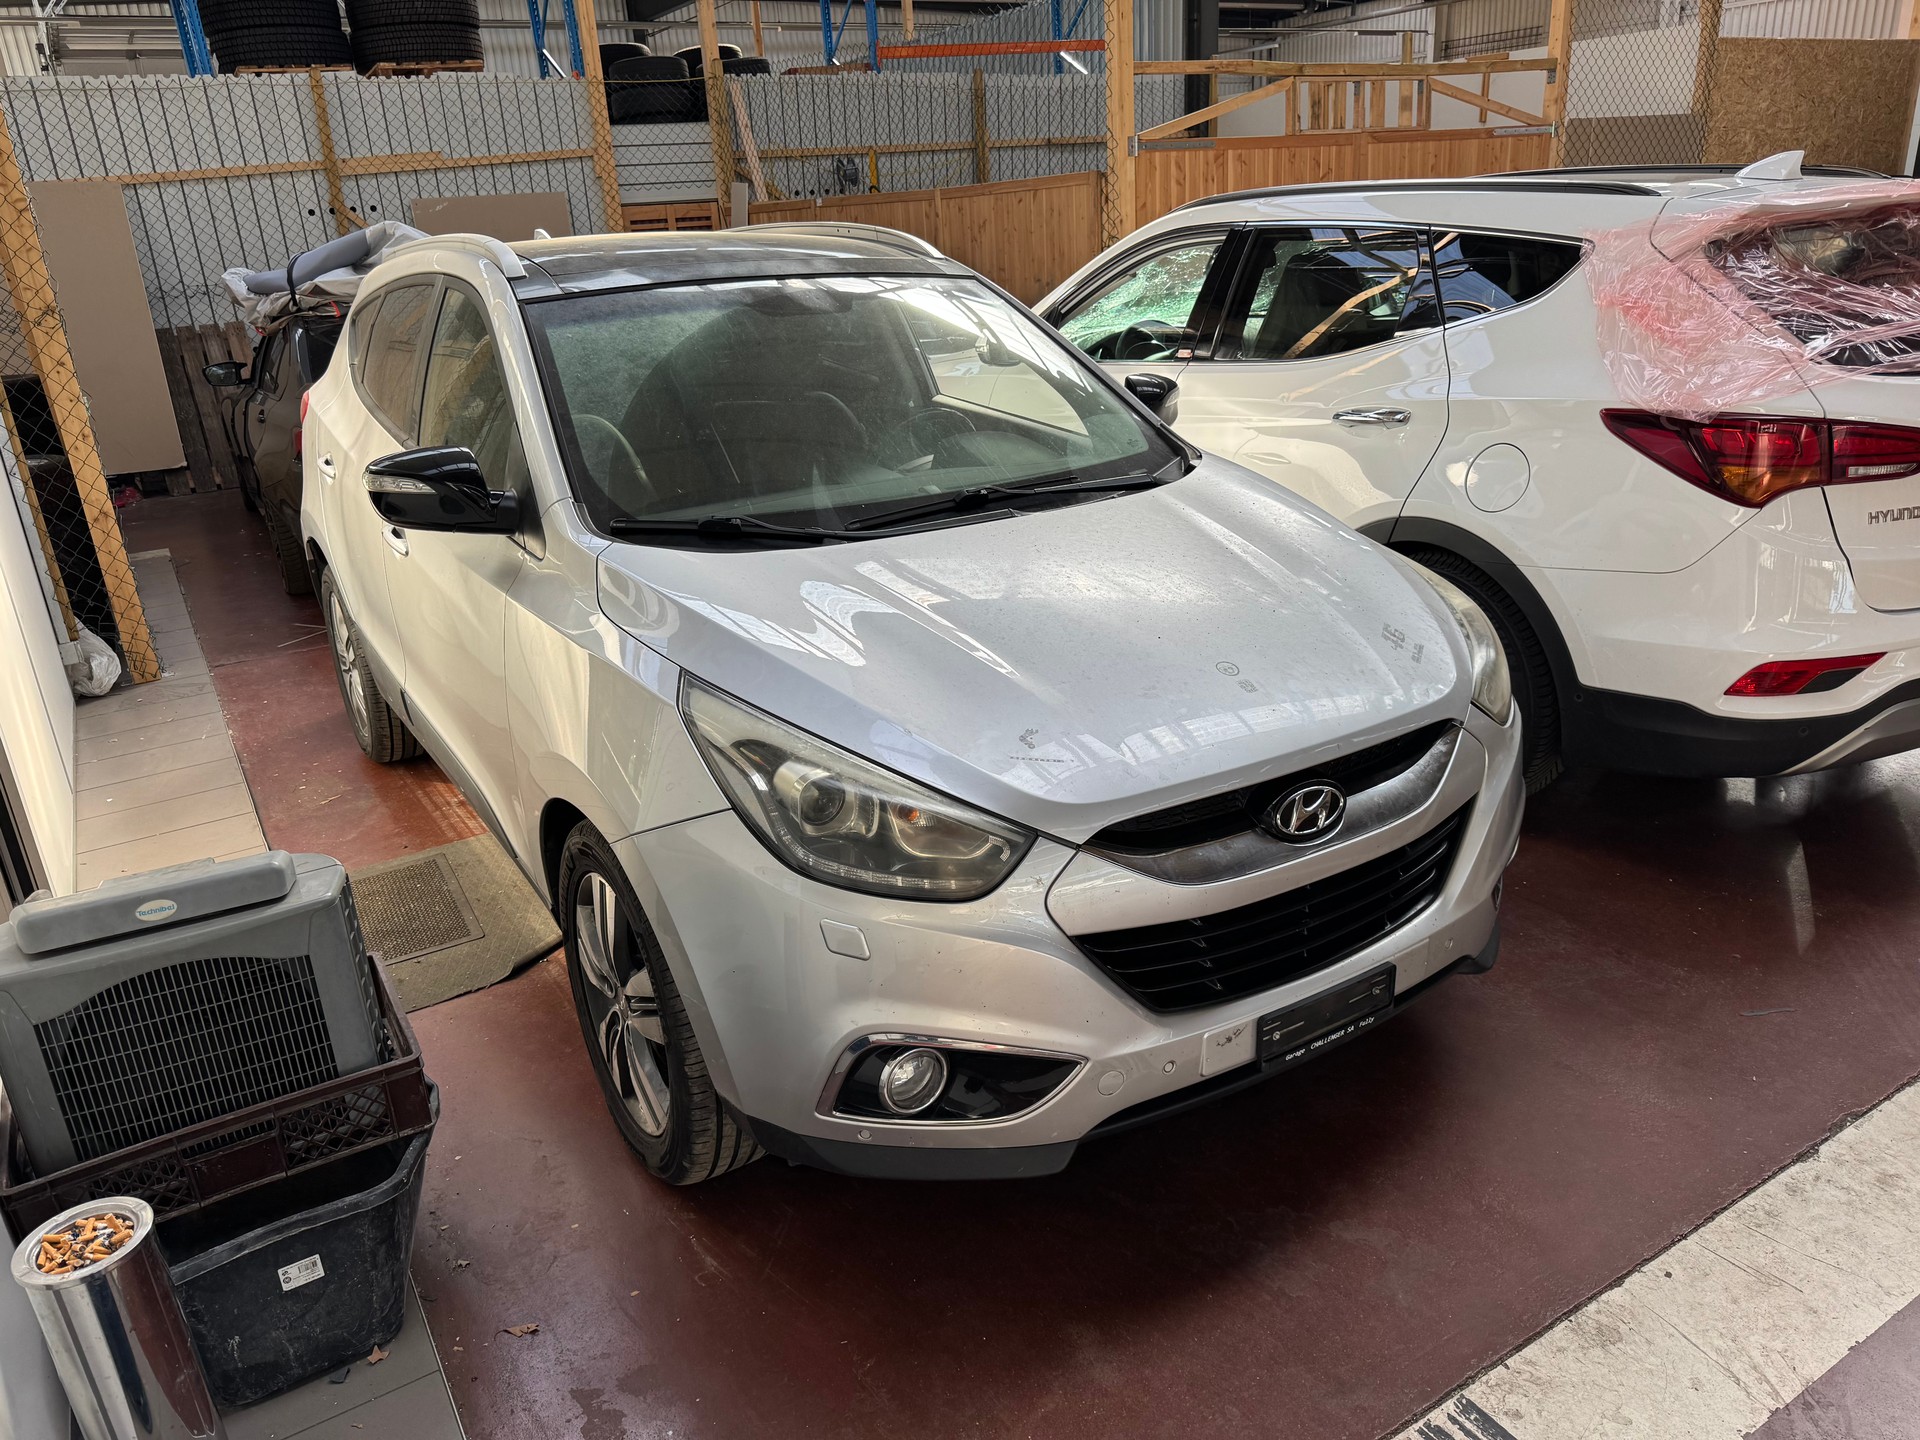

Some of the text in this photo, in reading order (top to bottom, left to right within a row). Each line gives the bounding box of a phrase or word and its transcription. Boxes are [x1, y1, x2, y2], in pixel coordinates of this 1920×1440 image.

[1285, 1048, 1306, 1061] Garage
[1310, 1029, 1345, 1050] CHALLENGER
[1346, 1025, 1355, 1034] SA
